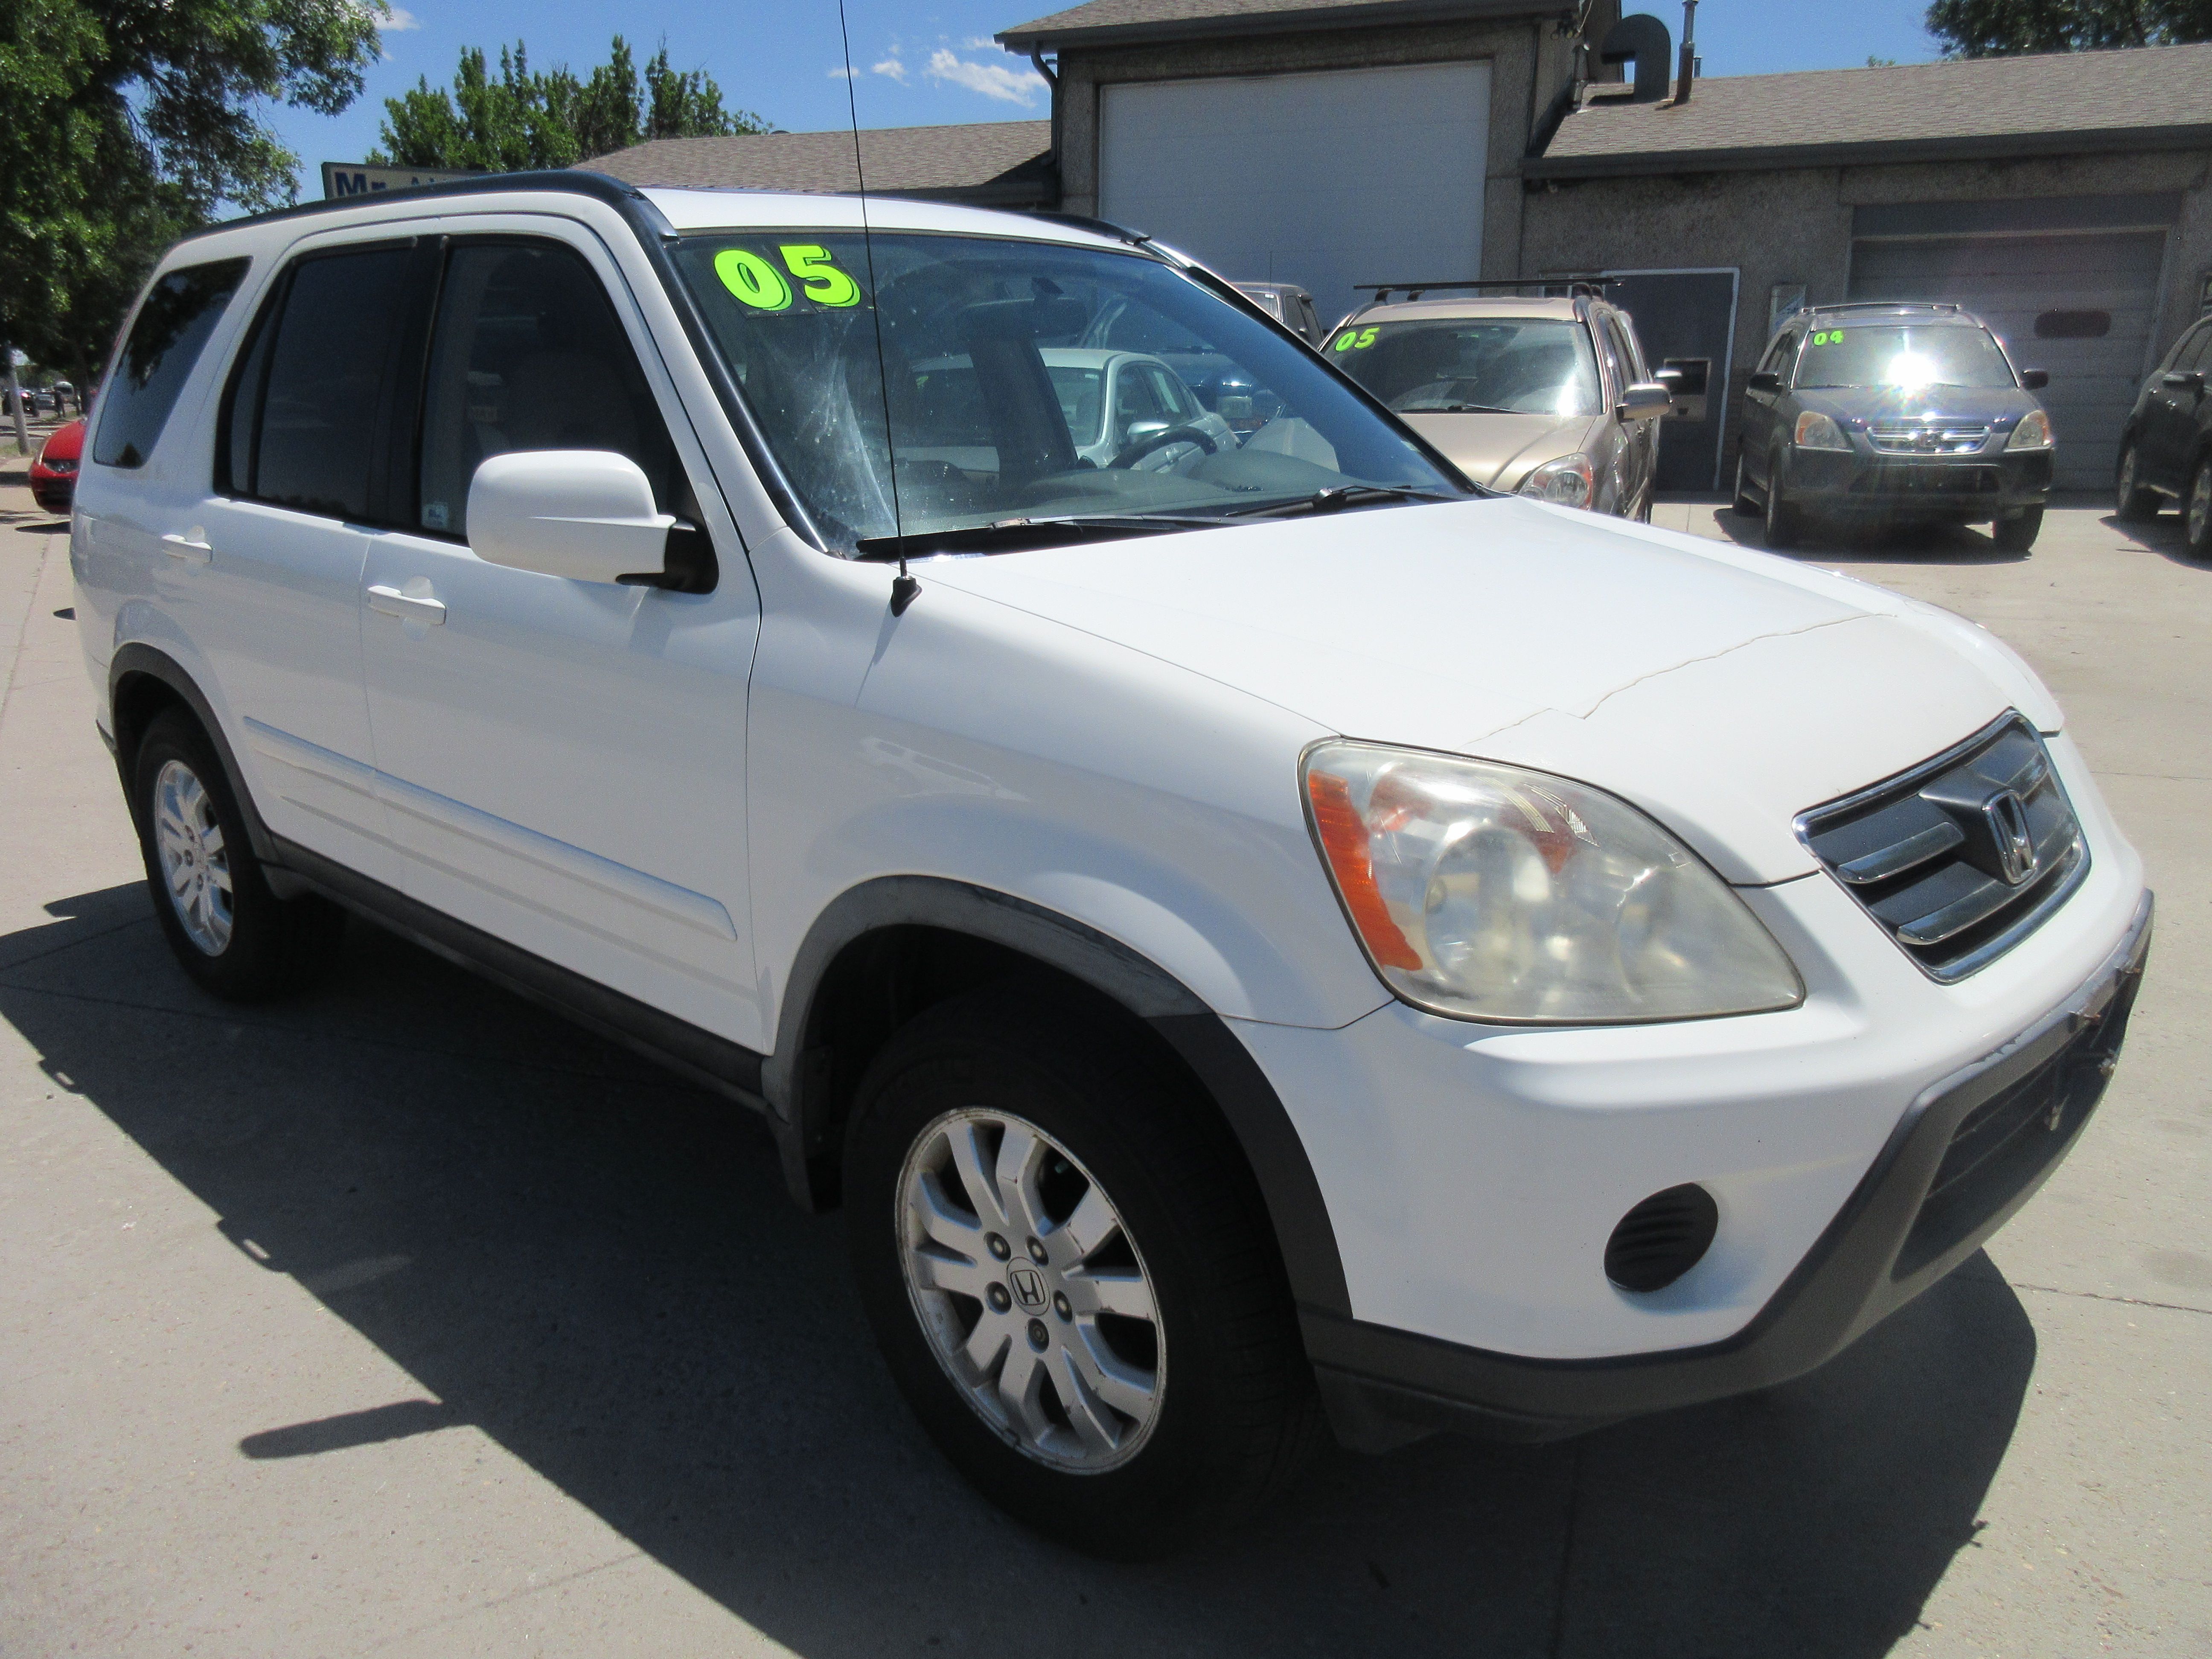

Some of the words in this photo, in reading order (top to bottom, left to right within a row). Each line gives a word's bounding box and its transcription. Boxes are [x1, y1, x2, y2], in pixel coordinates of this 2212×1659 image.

[713, 244, 861, 311] 05
[1336, 327, 1380, 352] 05
[1813, 330, 1844, 346] 04
